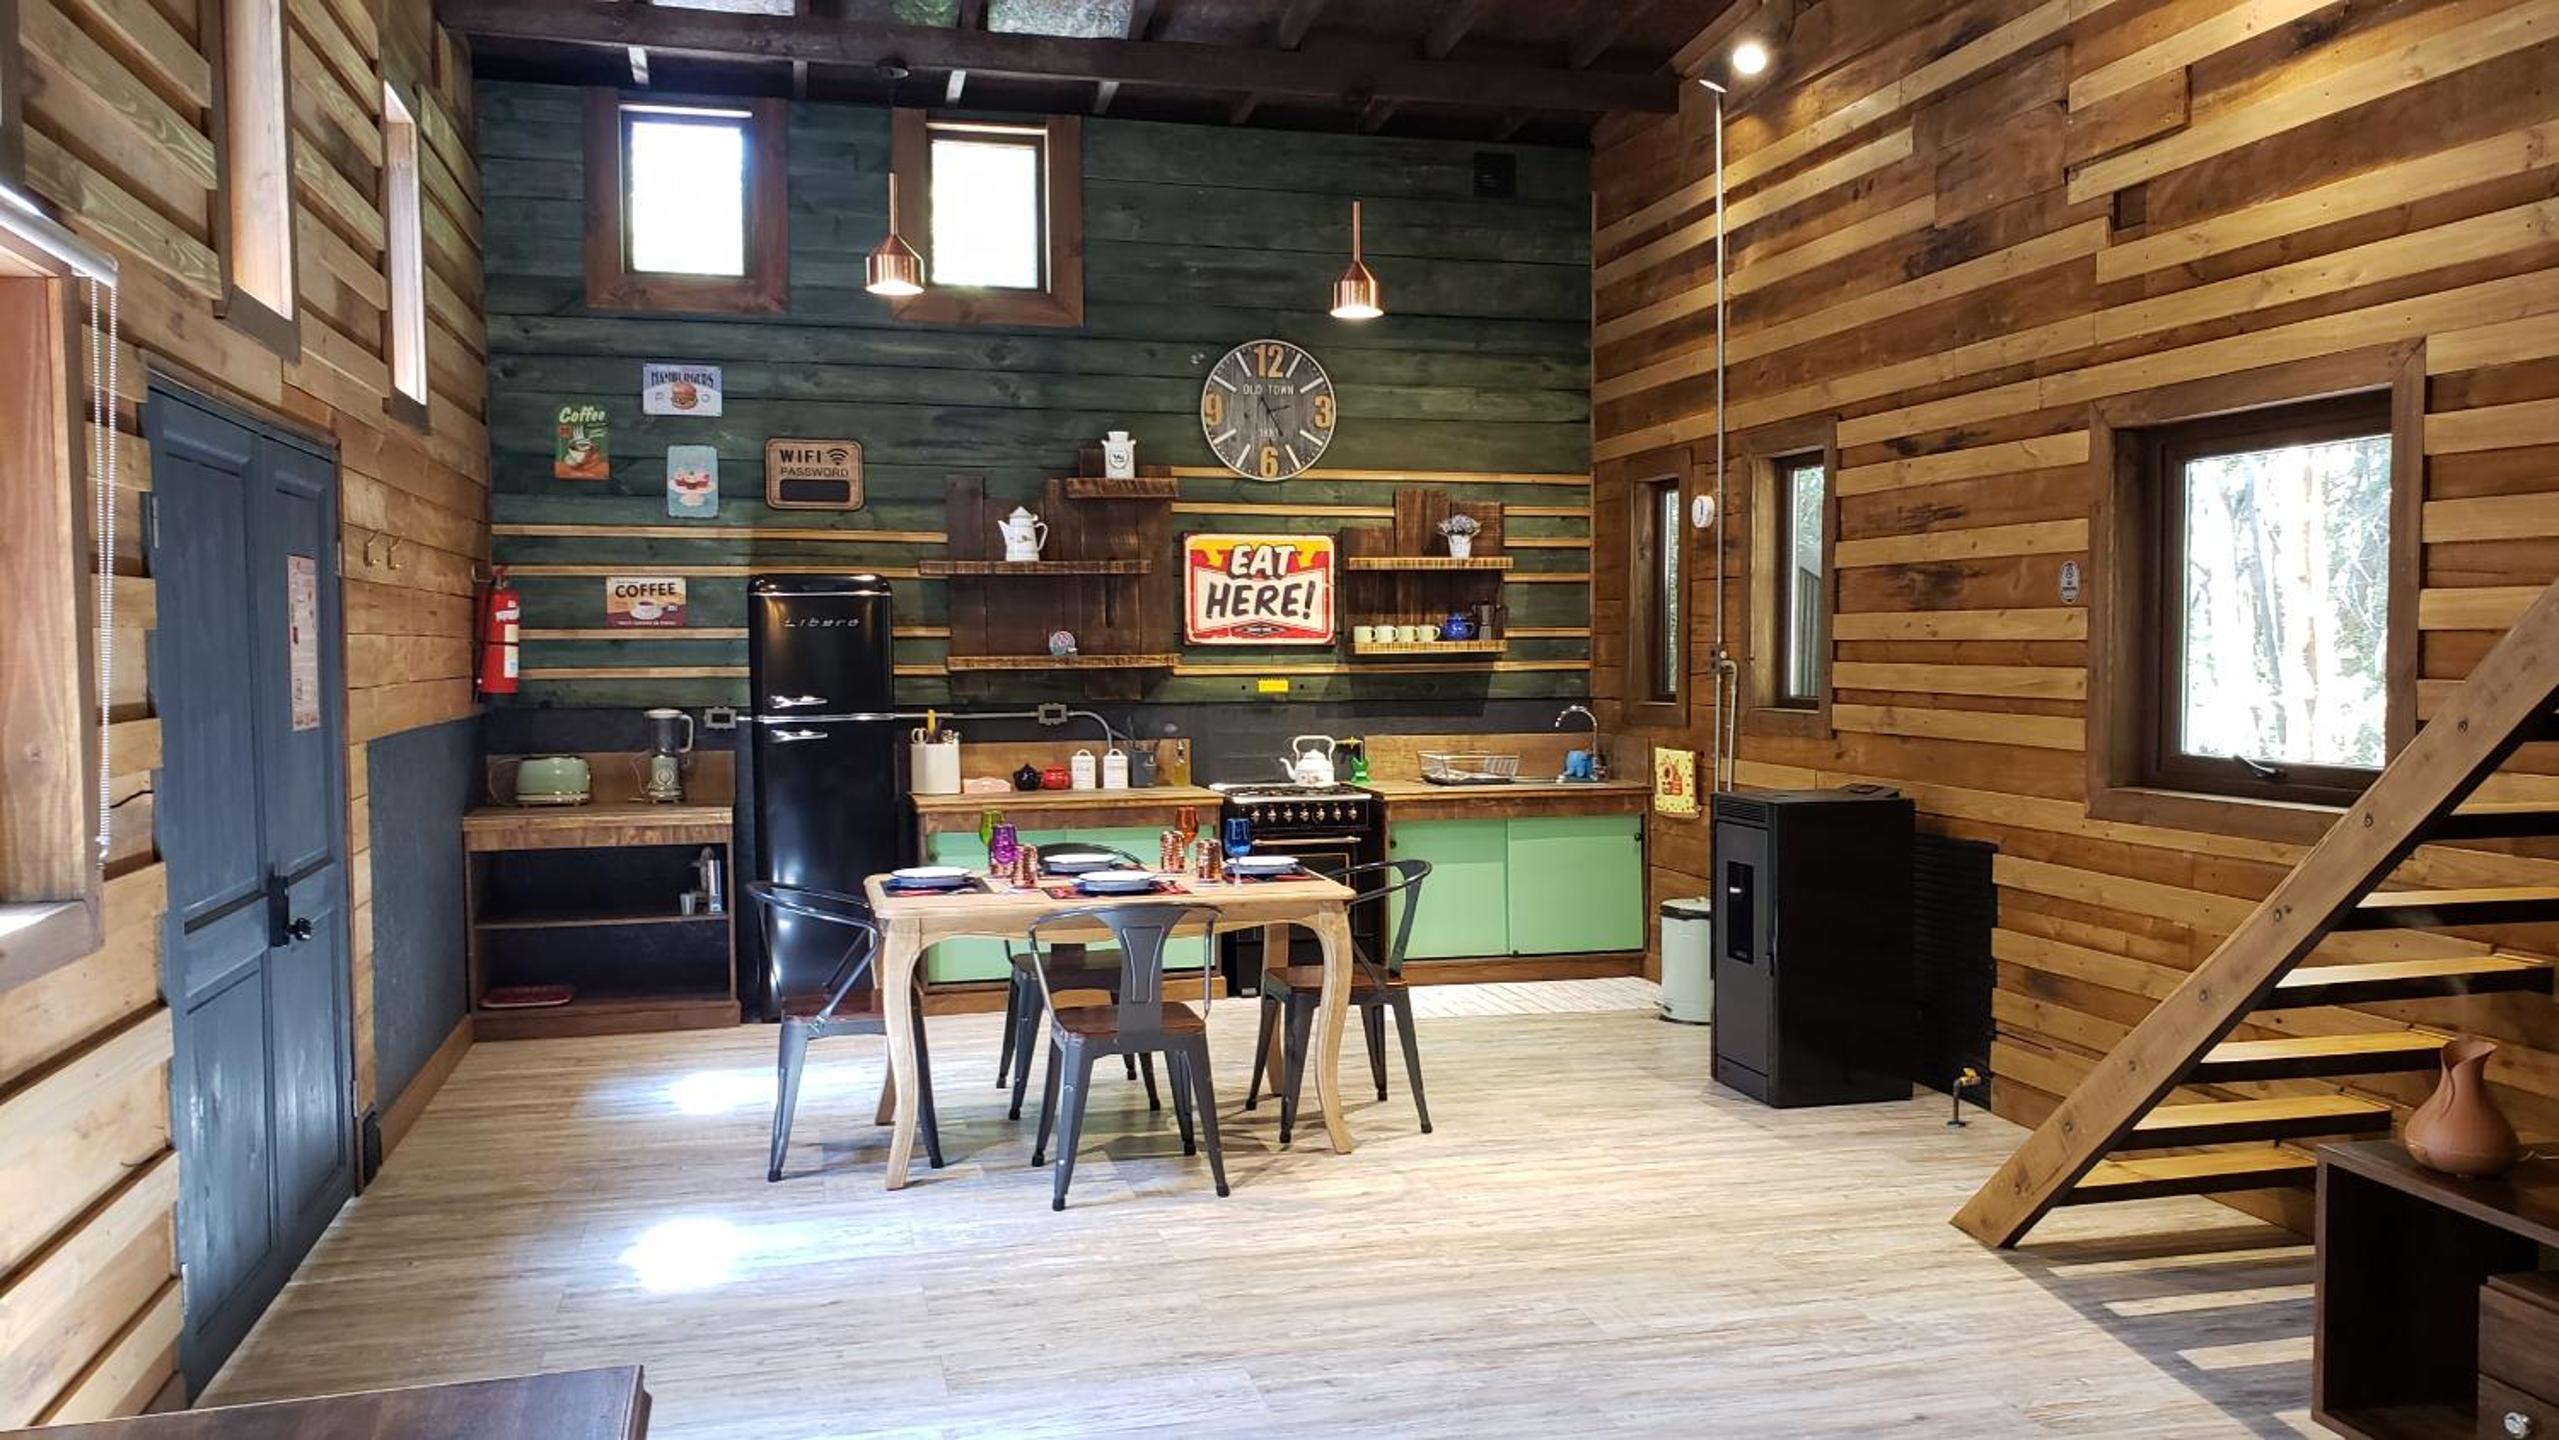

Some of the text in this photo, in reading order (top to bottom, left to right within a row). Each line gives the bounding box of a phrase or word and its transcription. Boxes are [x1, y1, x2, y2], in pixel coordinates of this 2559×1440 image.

[1253, 343, 1284, 378] 12
[651, 370, 714, 388] HAMBURGERS
[1242, 383, 1294, 395] OLD TOWN
[559, 405, 606, 424] Coffee
[1204, 392, 1222, 427] 9
[1313, 394, 1332, 429] 3
[779, 449, 821, 463] WIFI
[1260, 446, 1279, 478] 6
[780, 466, 849, 478] PASSWORD
[1228, 544, 1297, 581] EAT
[615, 582, 676, 598] COFFEE
[1205, 580, 1316, 620] HERE!
